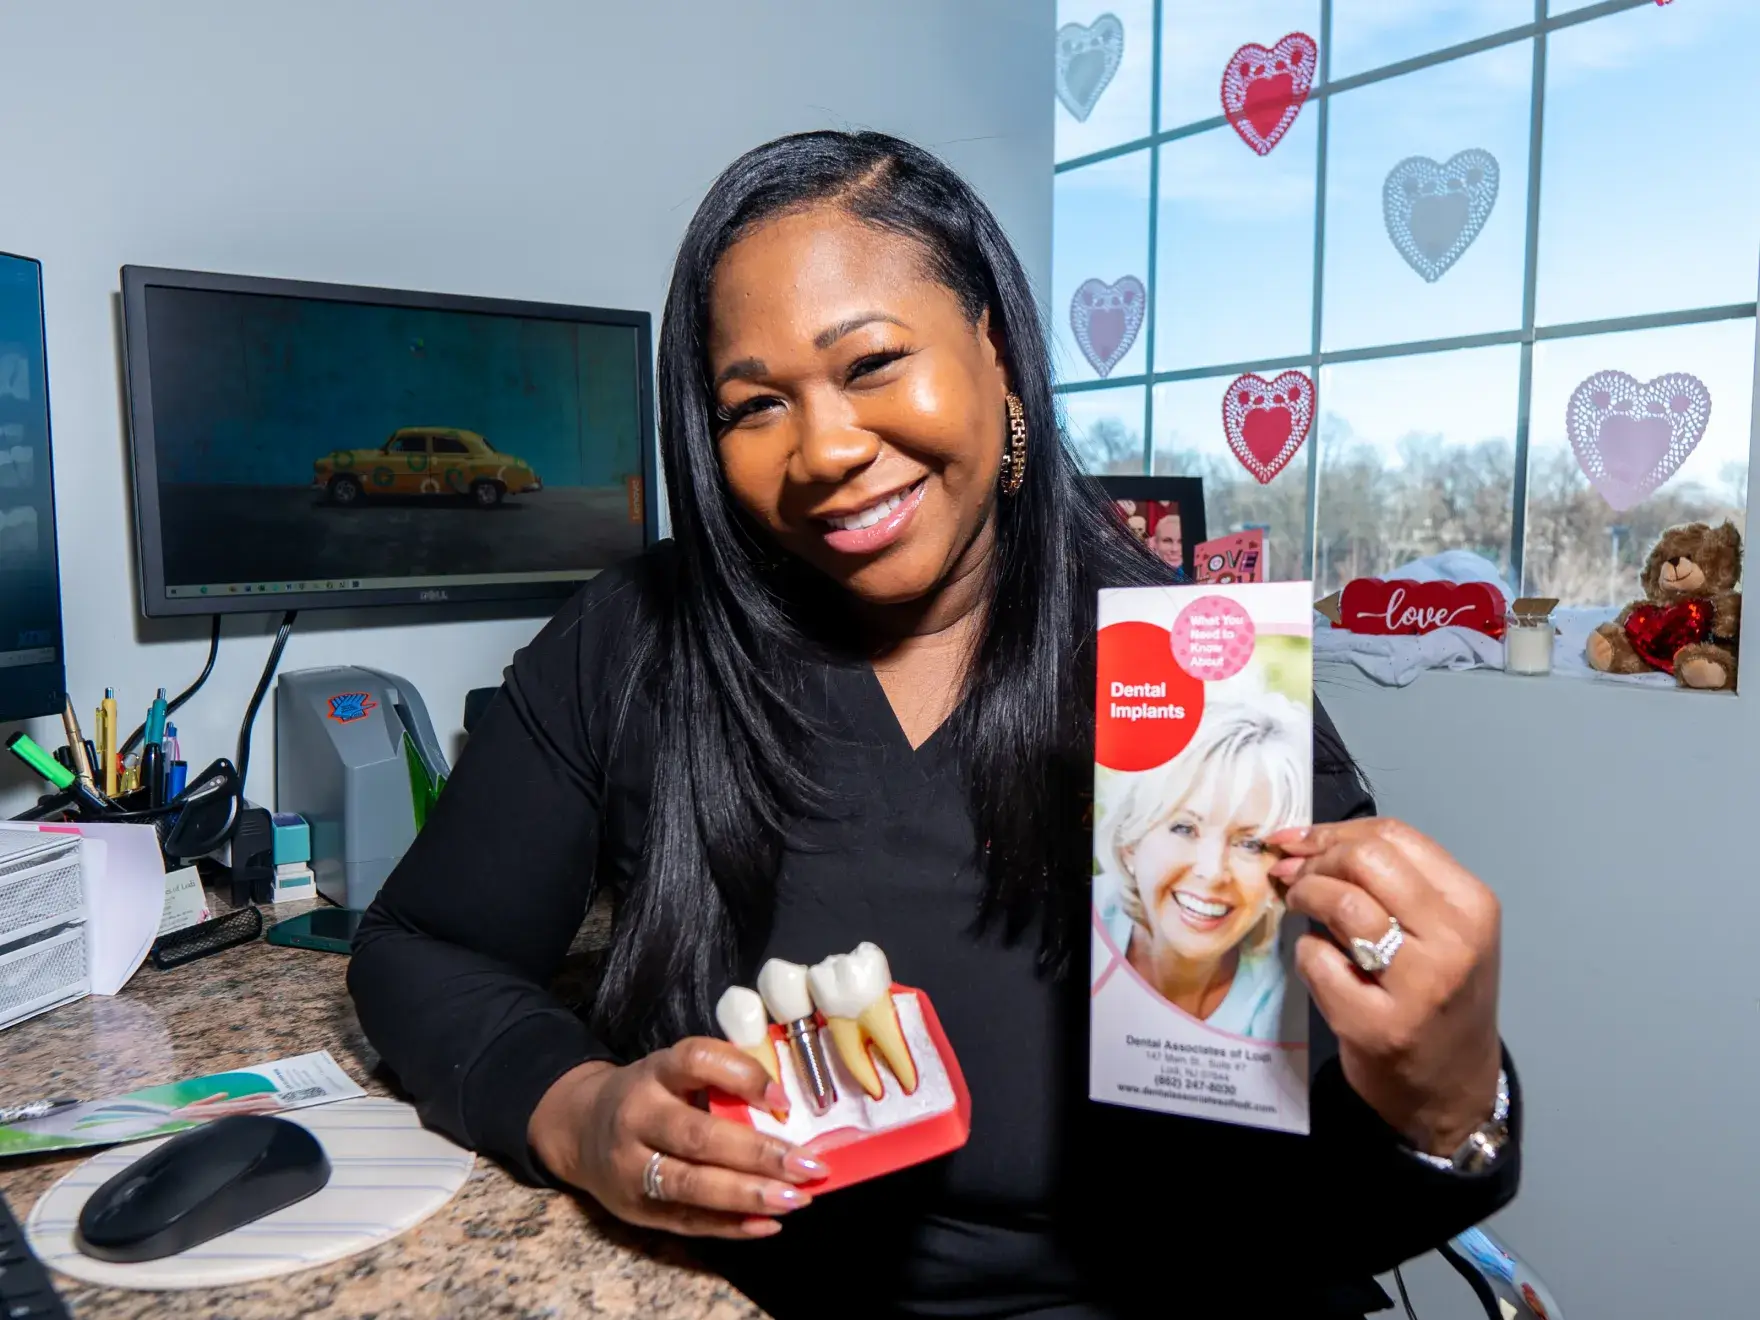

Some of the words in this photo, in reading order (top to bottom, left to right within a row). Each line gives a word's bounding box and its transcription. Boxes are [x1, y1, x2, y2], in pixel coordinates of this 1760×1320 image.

[1356, 588, 1476, 630] love
[1189, 615, 1220, 626] What
[1222, 615, 1244, 626] You
[1190, 629, 1220, 640] Need
[1222, 630, 1235, 640] to
[1190, 642, 1223, 653] Know
[1190, 656, 1224, 667] About
[1110, 681, 1166, 698] Dental
[1110, 703, 1185, 721] Implants
[1126, 1034, 1162, 1049] Dental
[1164, 1040, 1226, 1058] Associates
[1229, 1047, 1242, 1059] of
[1245, 1050, 1272, 1064] Lodi
